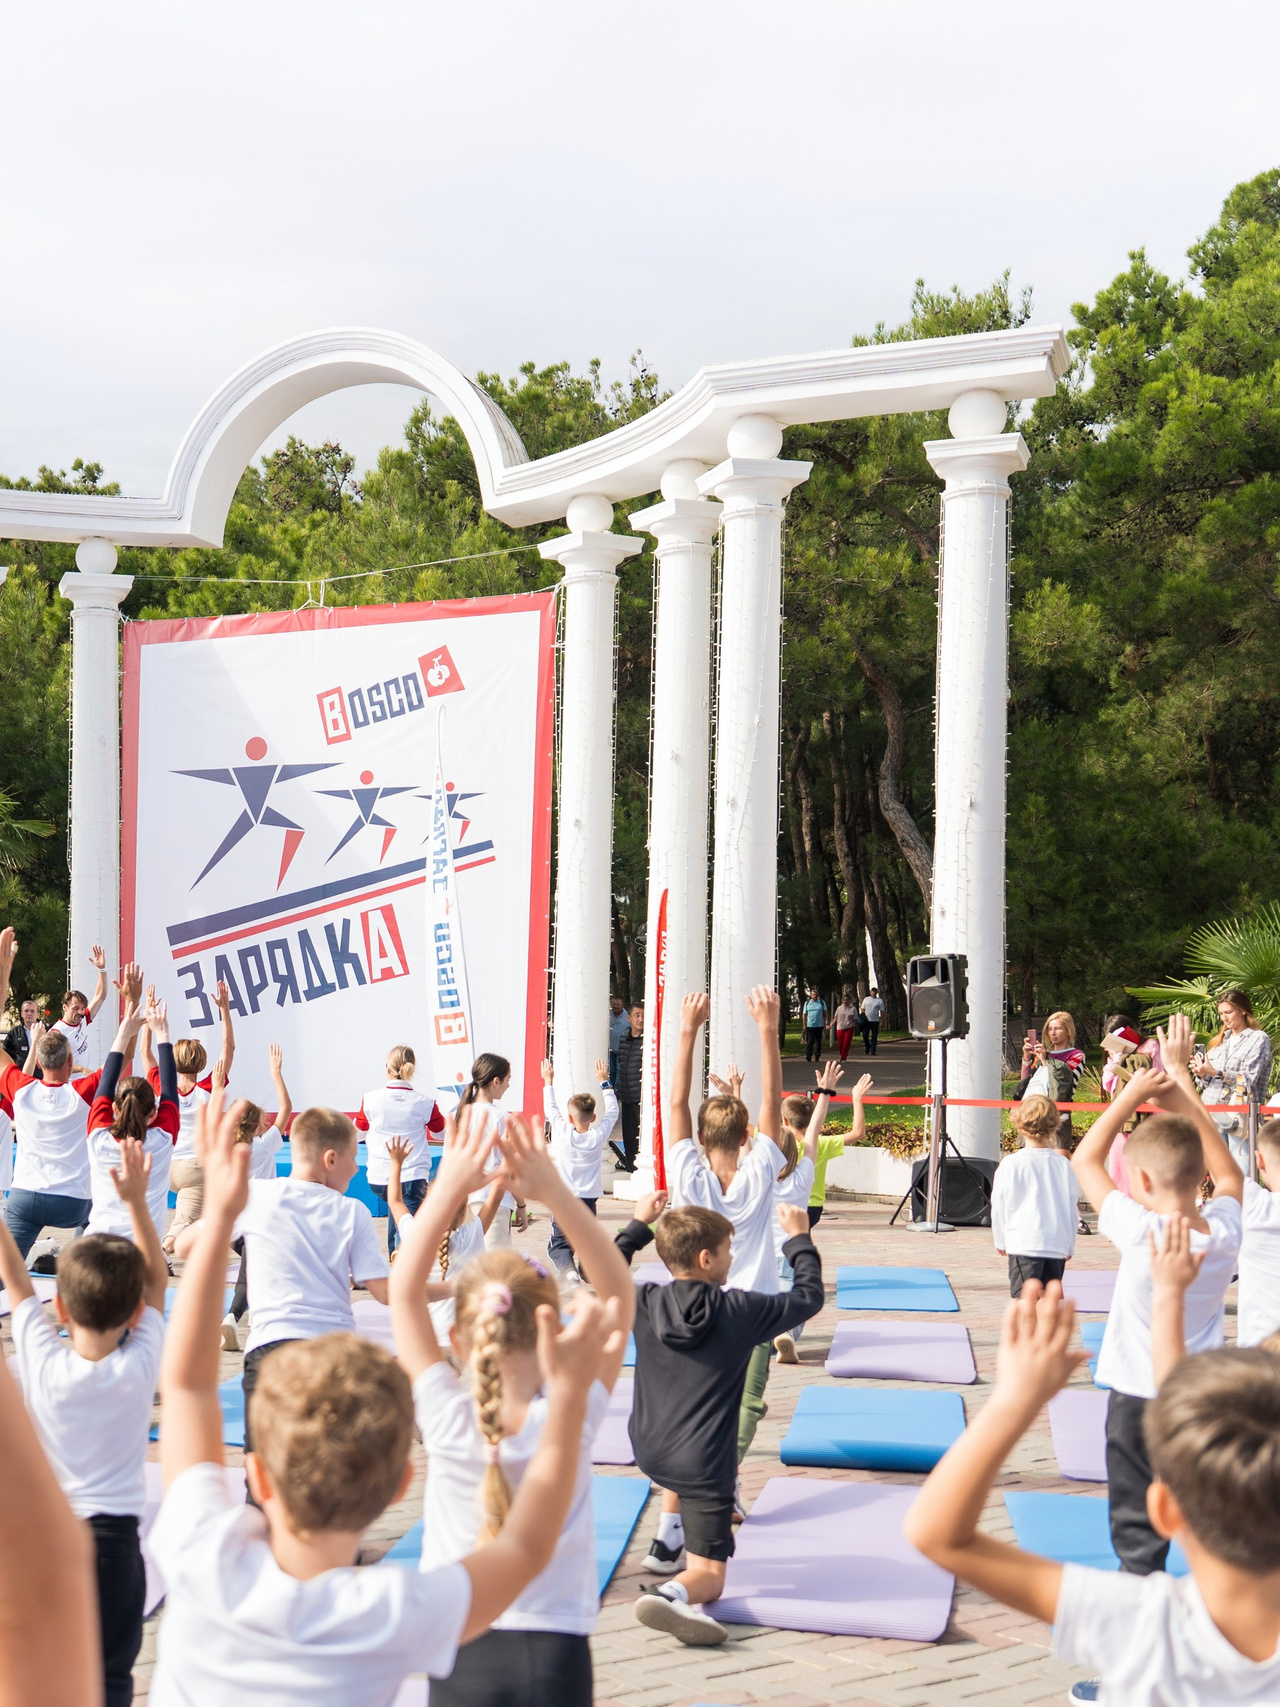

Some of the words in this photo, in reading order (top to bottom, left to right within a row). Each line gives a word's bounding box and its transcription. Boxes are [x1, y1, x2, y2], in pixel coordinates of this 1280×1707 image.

[317, 672, 425, 745] BOSCO
[177, 903, 410, 1028] ЗАРЯДКА
[434, 922, 469, 1046] BOSCO
